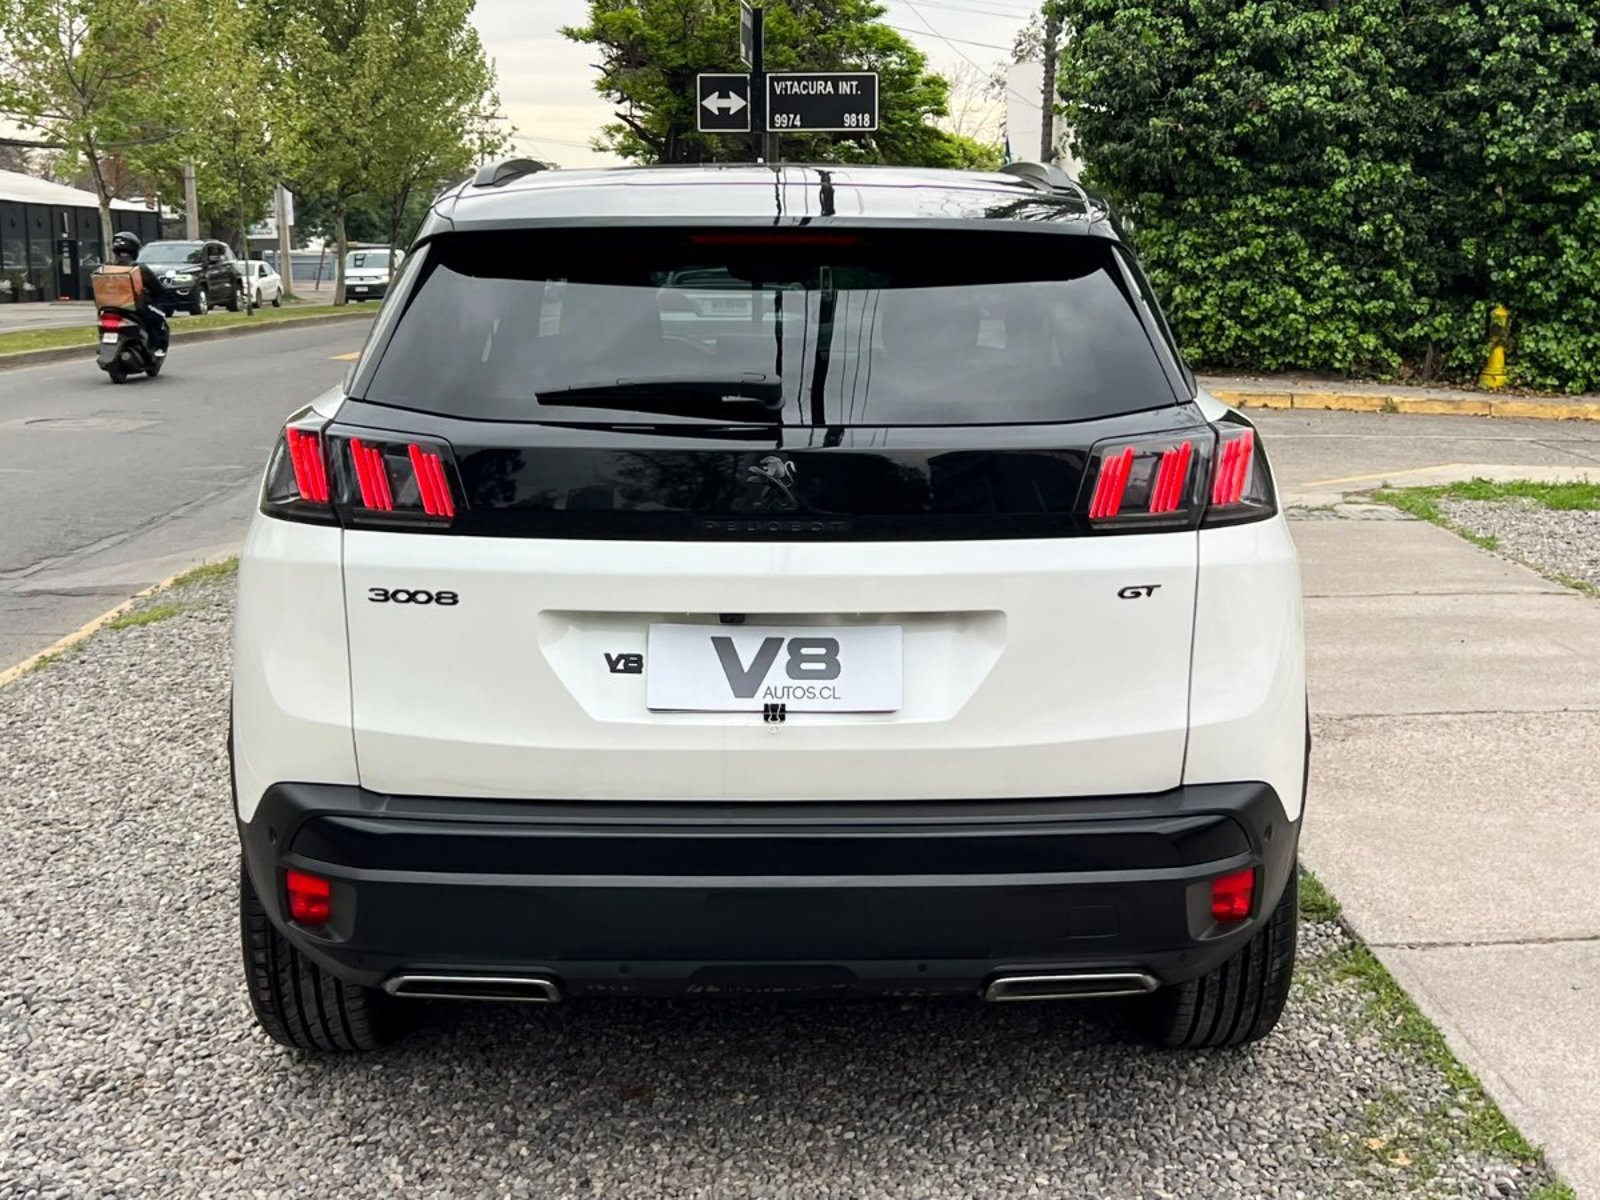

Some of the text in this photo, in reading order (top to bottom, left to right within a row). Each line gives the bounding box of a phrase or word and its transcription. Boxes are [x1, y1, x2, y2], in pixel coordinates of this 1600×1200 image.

[774, 81, 861, 95] VITACURA INT.
[774, 113, 870, 128] 9974 9818
[368, 588, 459, 606] 3008
[1117, 584, 1162, 599] GT
[604, 653, 644, 674] V8
[711, 636, 841, 698] V8
[762, 686, 841, 700] AUTOS.CL
